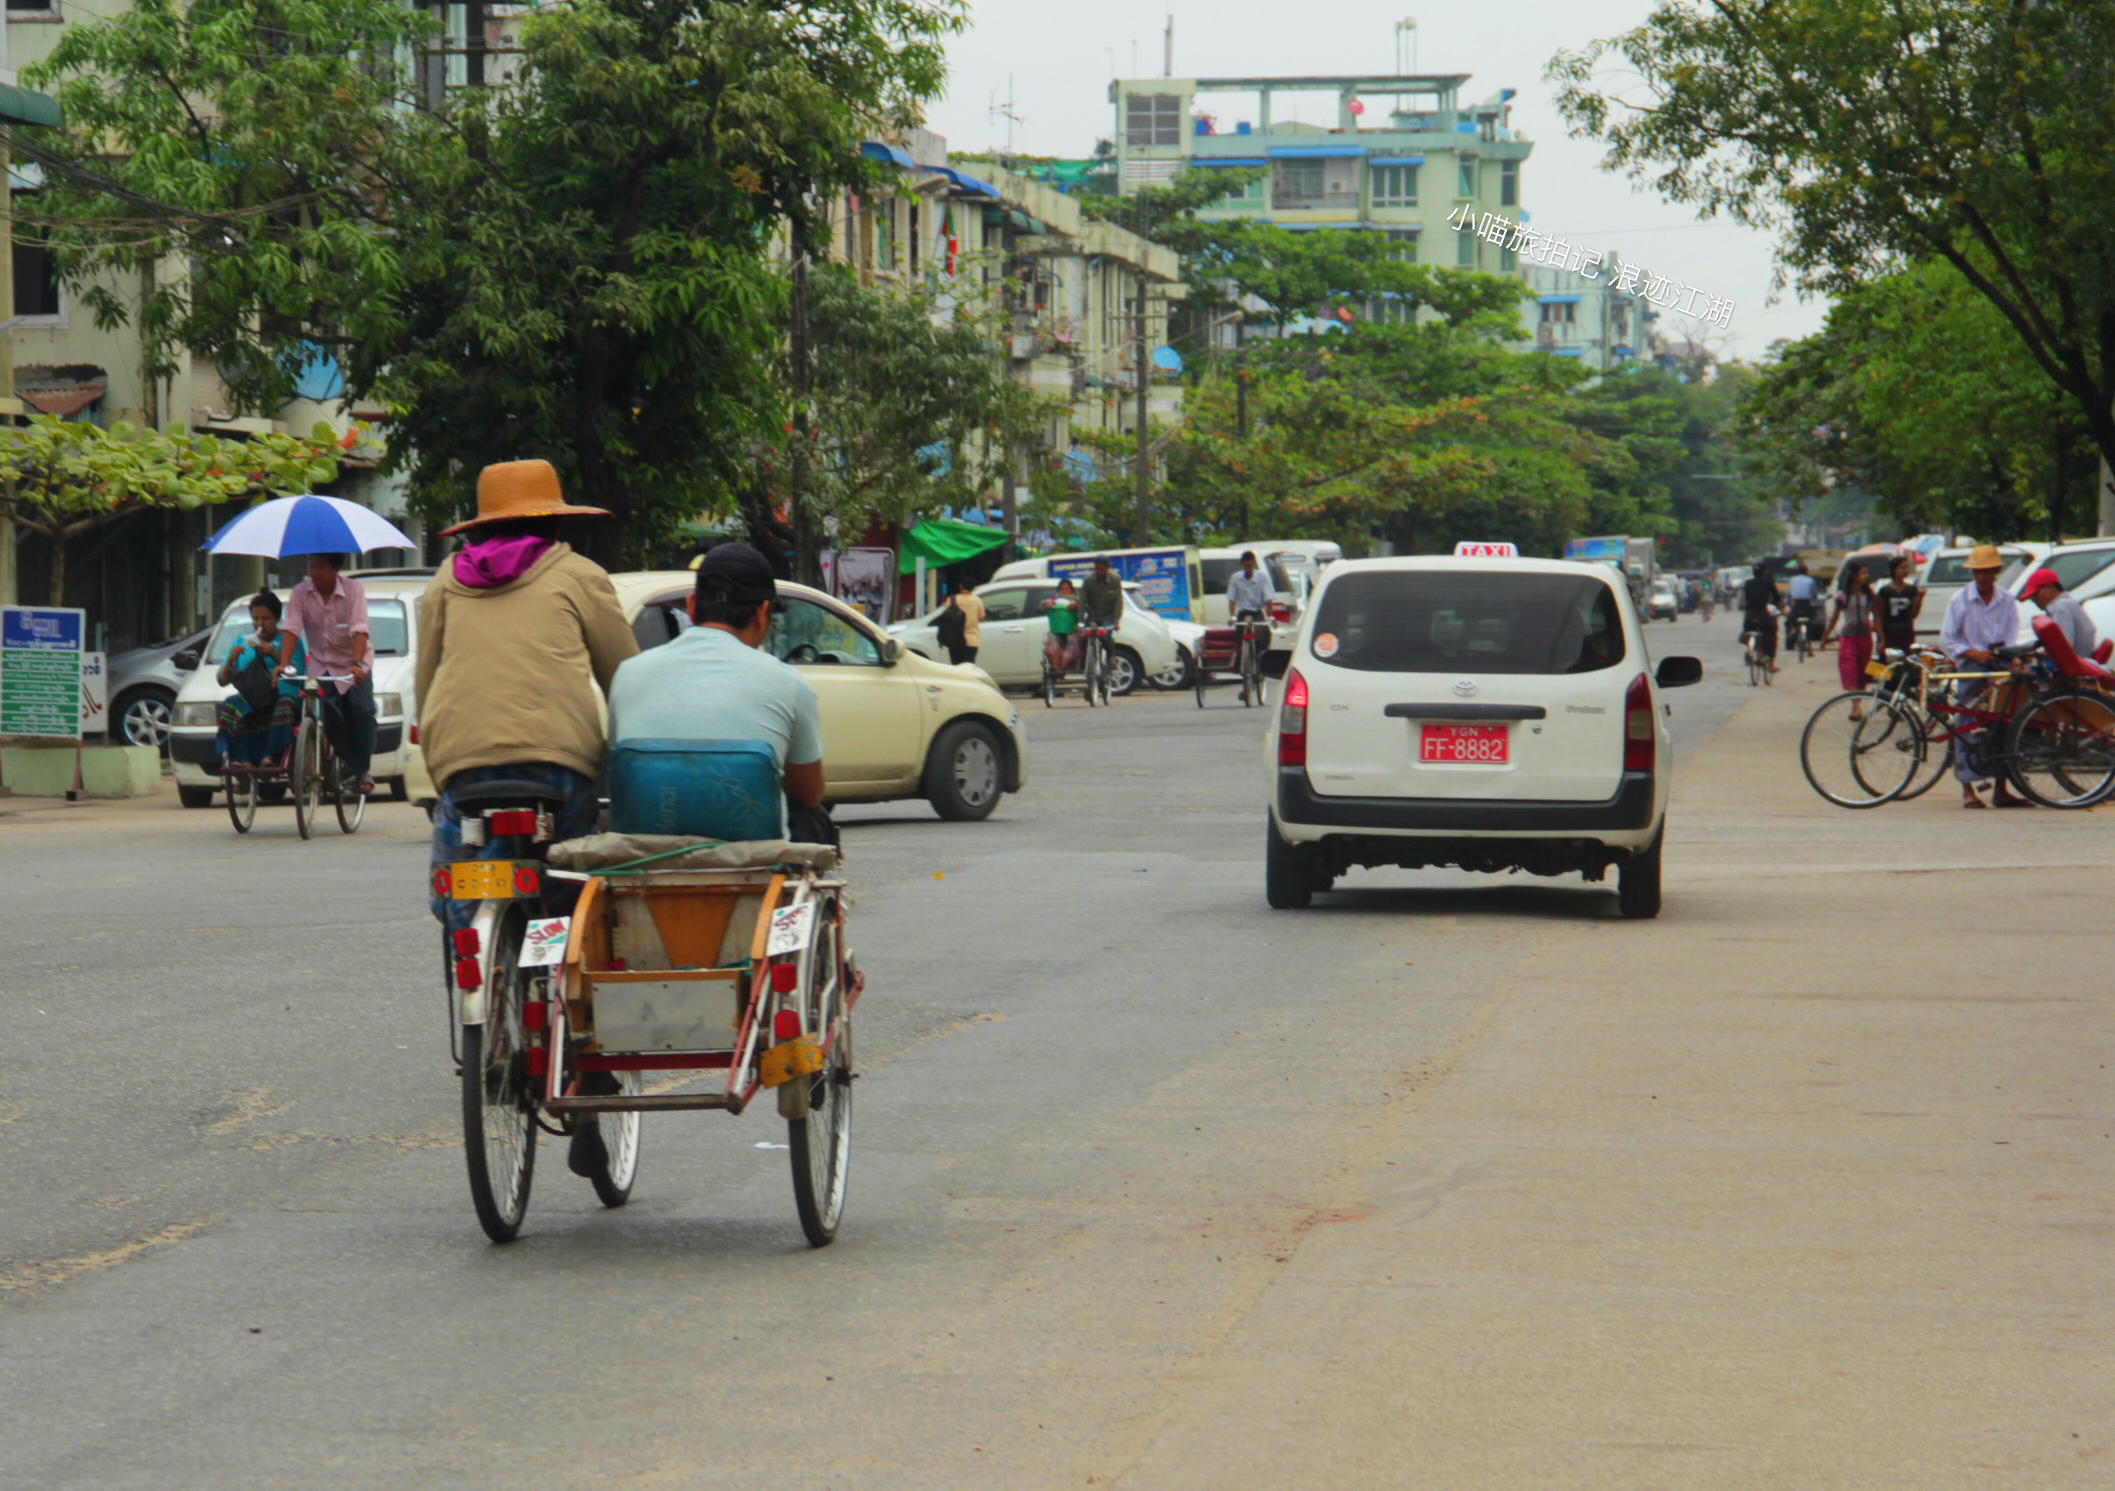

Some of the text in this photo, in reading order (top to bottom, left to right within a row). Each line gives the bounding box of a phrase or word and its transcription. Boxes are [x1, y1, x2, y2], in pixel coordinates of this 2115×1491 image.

[1462, 543, 1510, 557] TAXI
[1890, 597, 1910, 616] P
[1449, 726, 1480, 737] YGN
[1424, 737, 1504, 760] FF-8882
